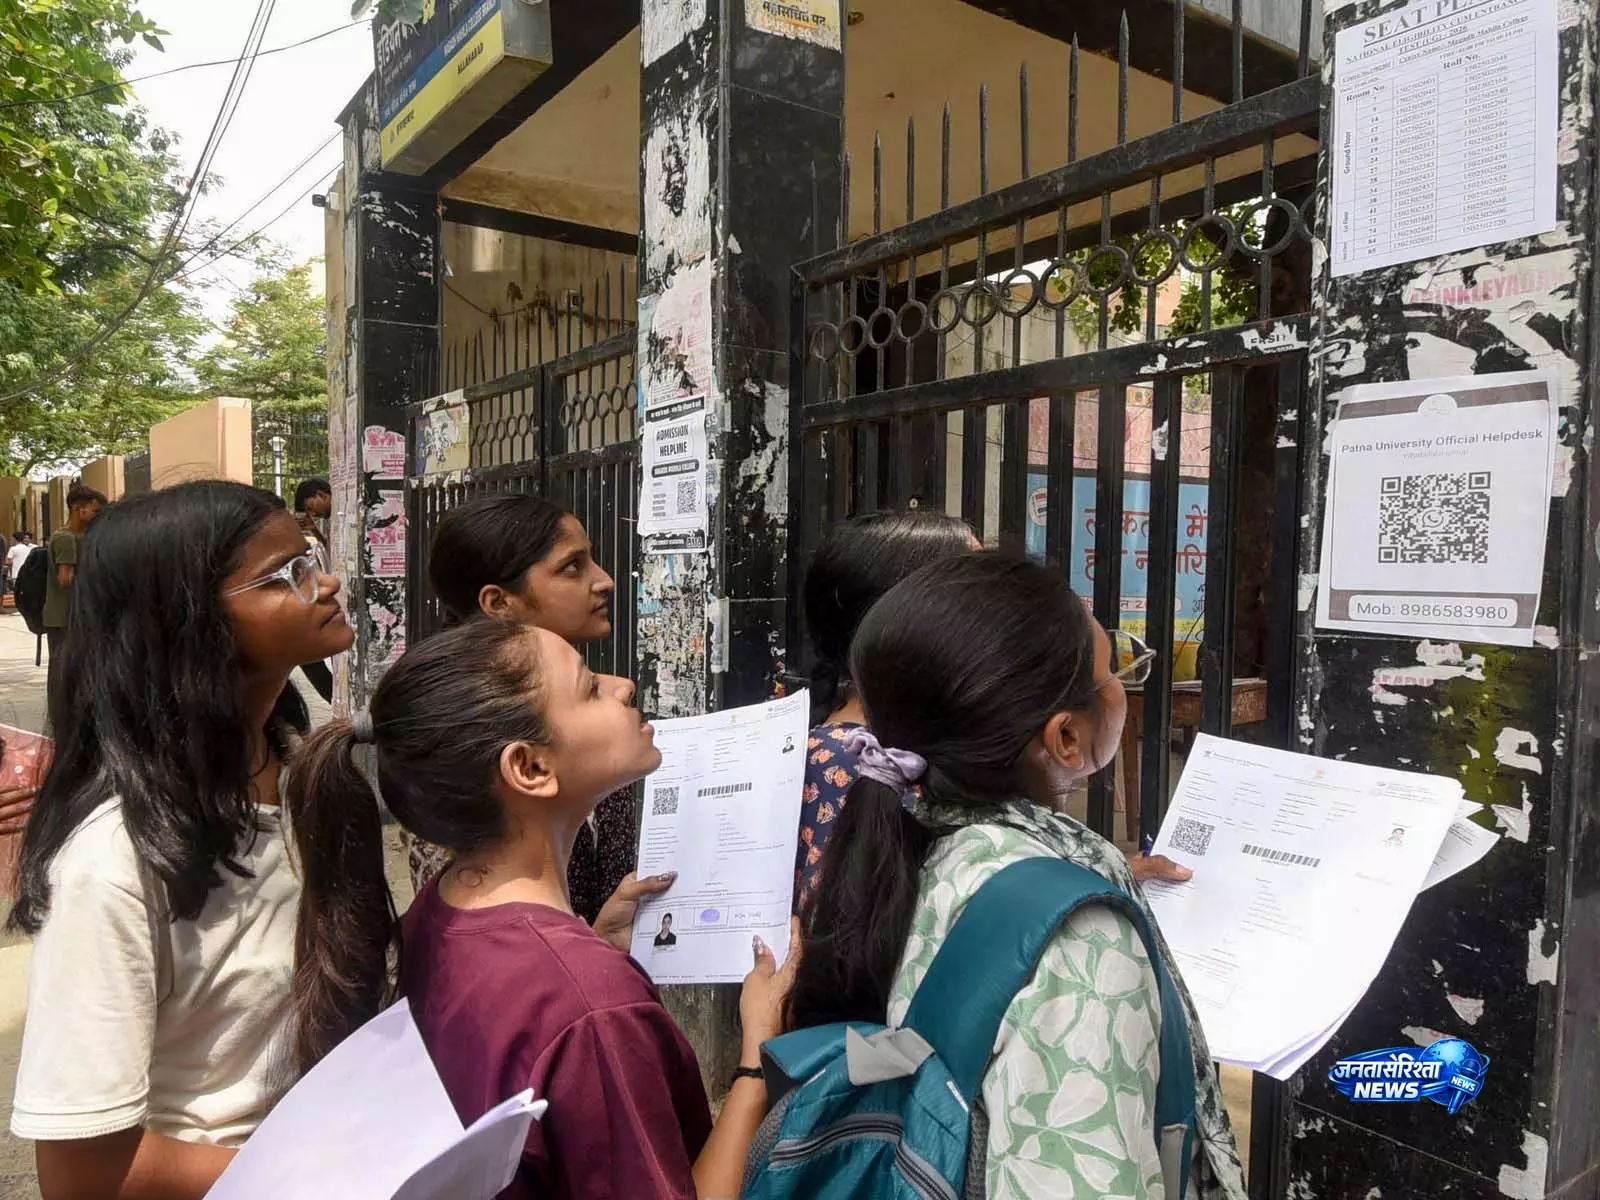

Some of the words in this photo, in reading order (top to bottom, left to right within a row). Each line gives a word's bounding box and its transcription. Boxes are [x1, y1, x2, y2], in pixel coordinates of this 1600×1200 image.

[1364, 6, 1428, 43] SEAT
[457, 42, 484, 74] ALLAHABAD
[1442, 56, 1462, 70] Roll
[656, 424, 689, 441] ADMISSION
[1342, 443, 1373, 454] Patna
[1375, 438, 1433, 450] University
[1435, 434, 1479, 446] Official
[1483, 429, 1543, 443] Helpdesk
[659, 441, 688, 457] HELPLINE
[1185, 503, 1208, 538] में
[1357, 602, 1396, 616] Mob:
[1400, 604, 1508, 619] 8986583980
